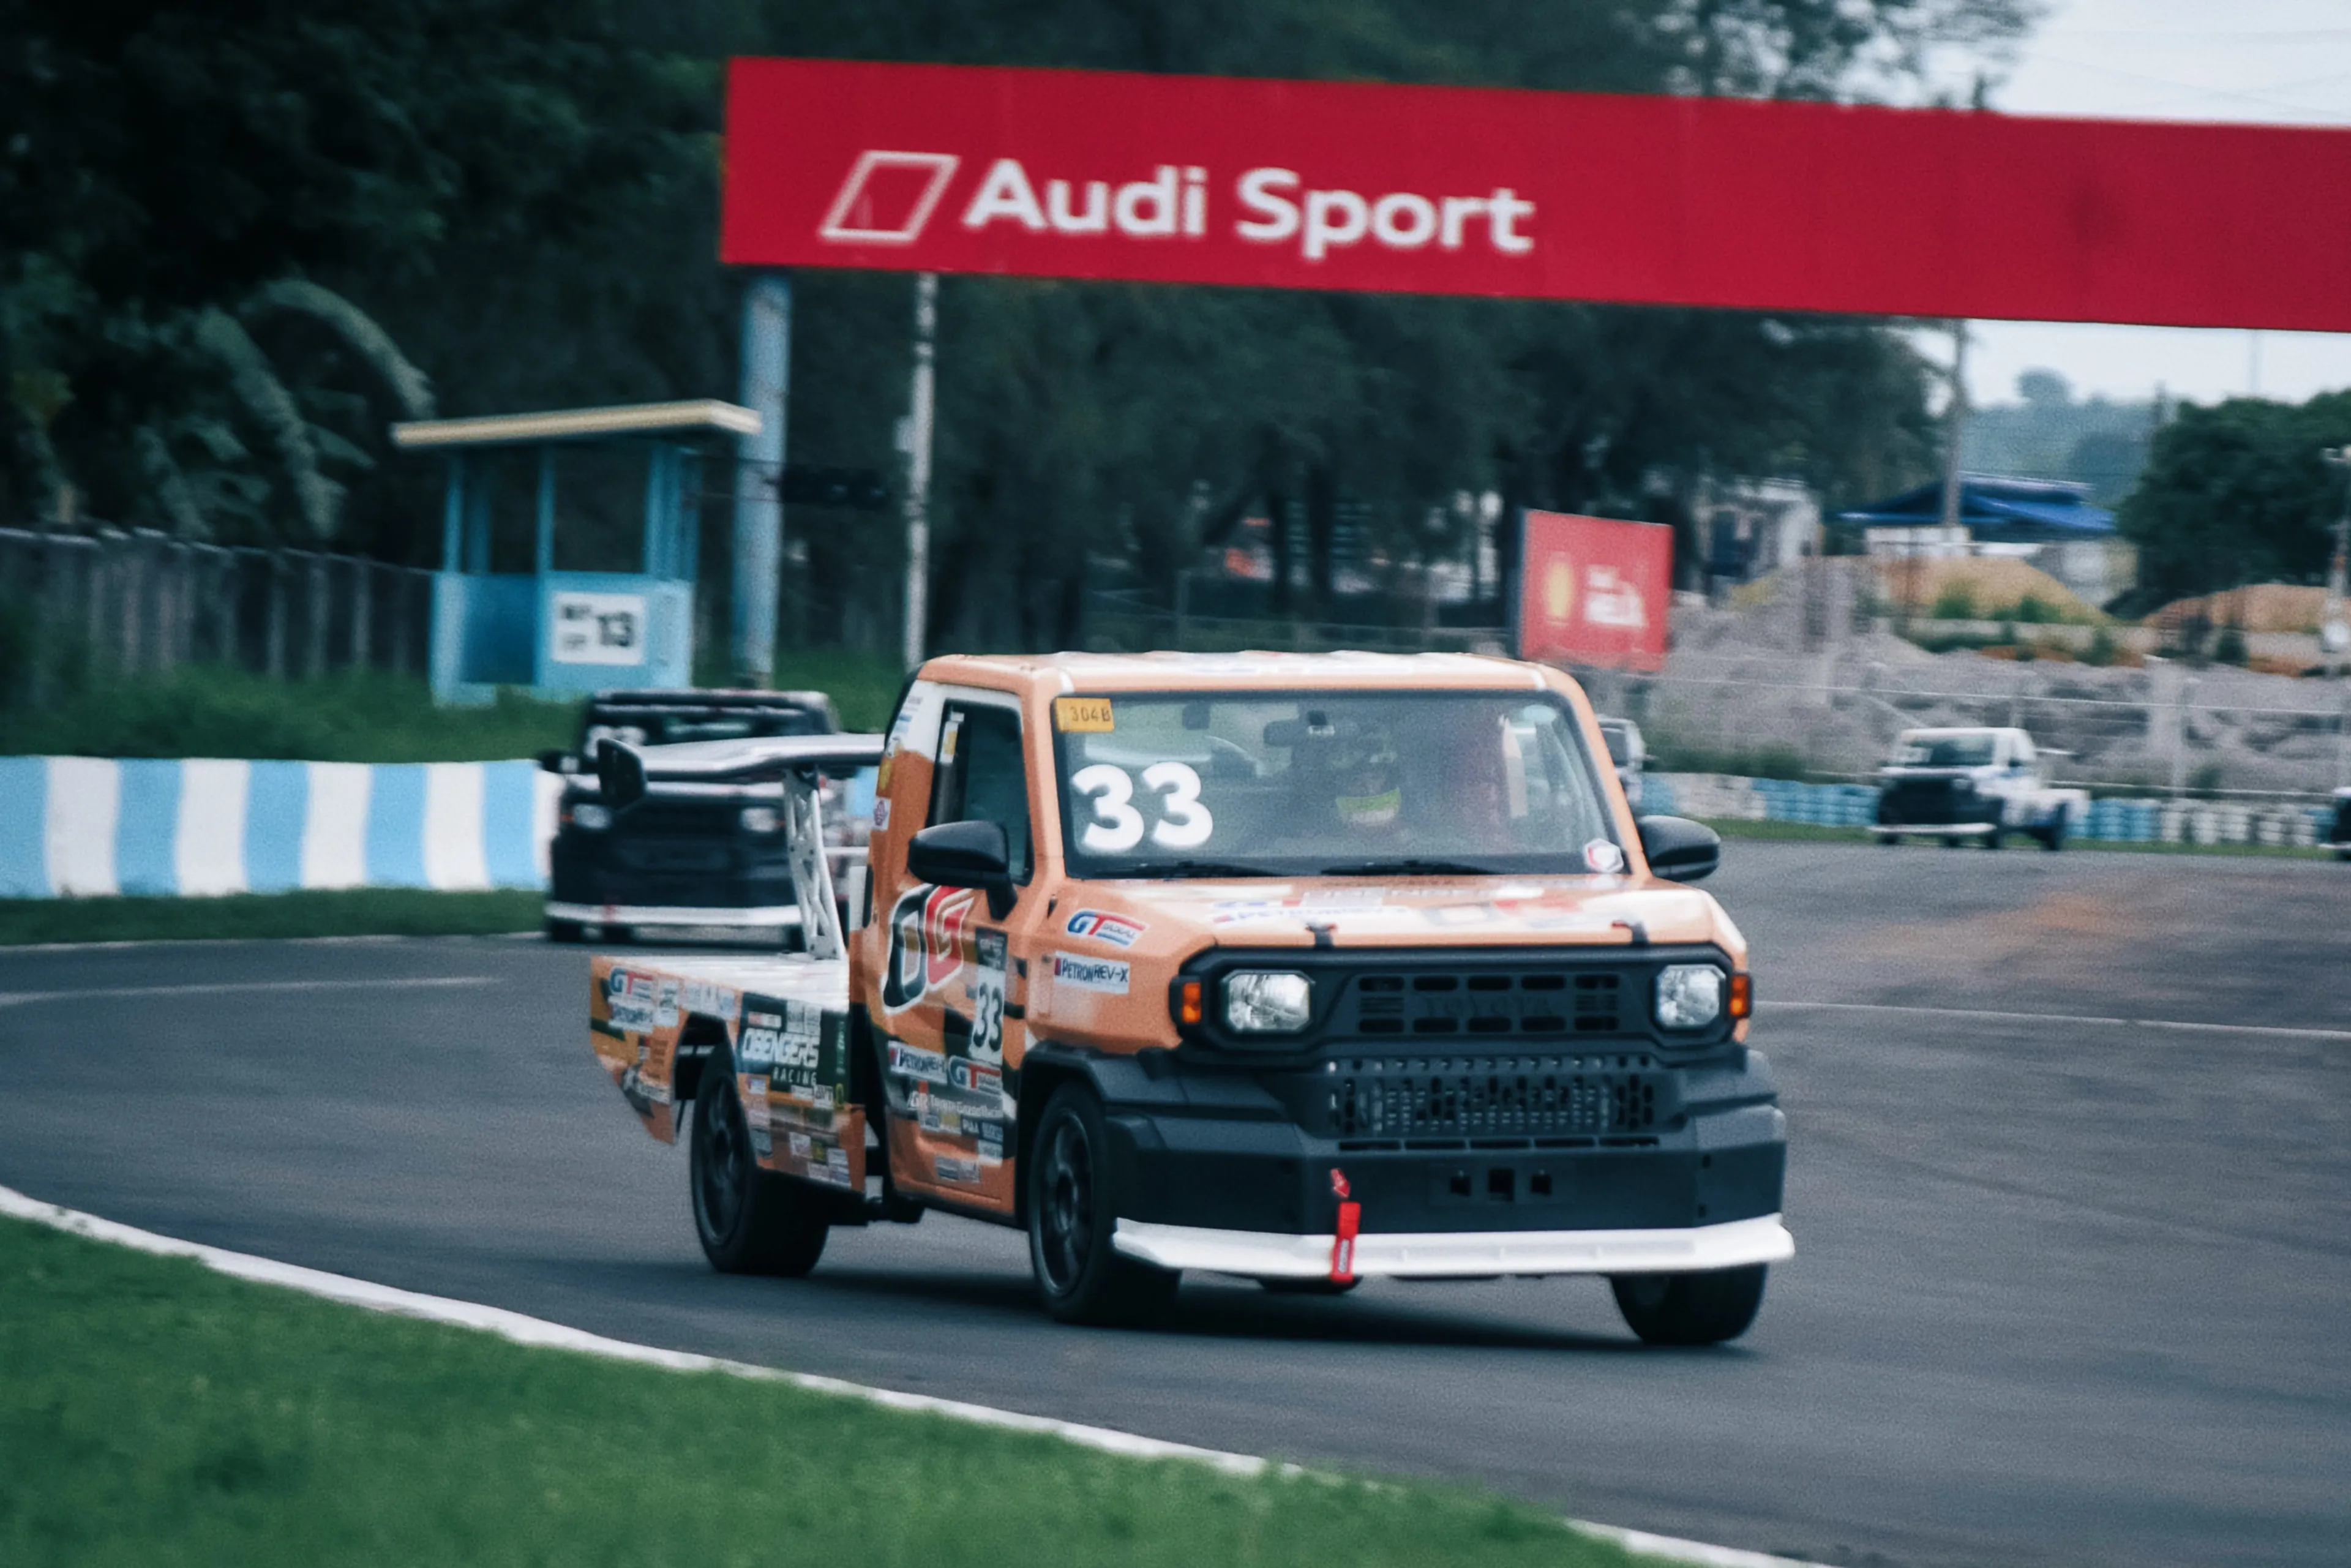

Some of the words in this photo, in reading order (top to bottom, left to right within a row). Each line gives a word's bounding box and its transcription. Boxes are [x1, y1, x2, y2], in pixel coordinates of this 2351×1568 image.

[963, 157, 1207, 238] Audi
[1235, 167, 1535, 261] Sport
[1071, 762, 1213, 850] 33
[1067, 910, 1146, 936] GT
[1062, 958, 1093, 982] PETRON
[1093, 964, 1128, 982] REV-X
[973, 983, 1002, 1052] 33
[773, 1067, 817, 1087] RACING
[950, 1058, 1001, 1089] GT
